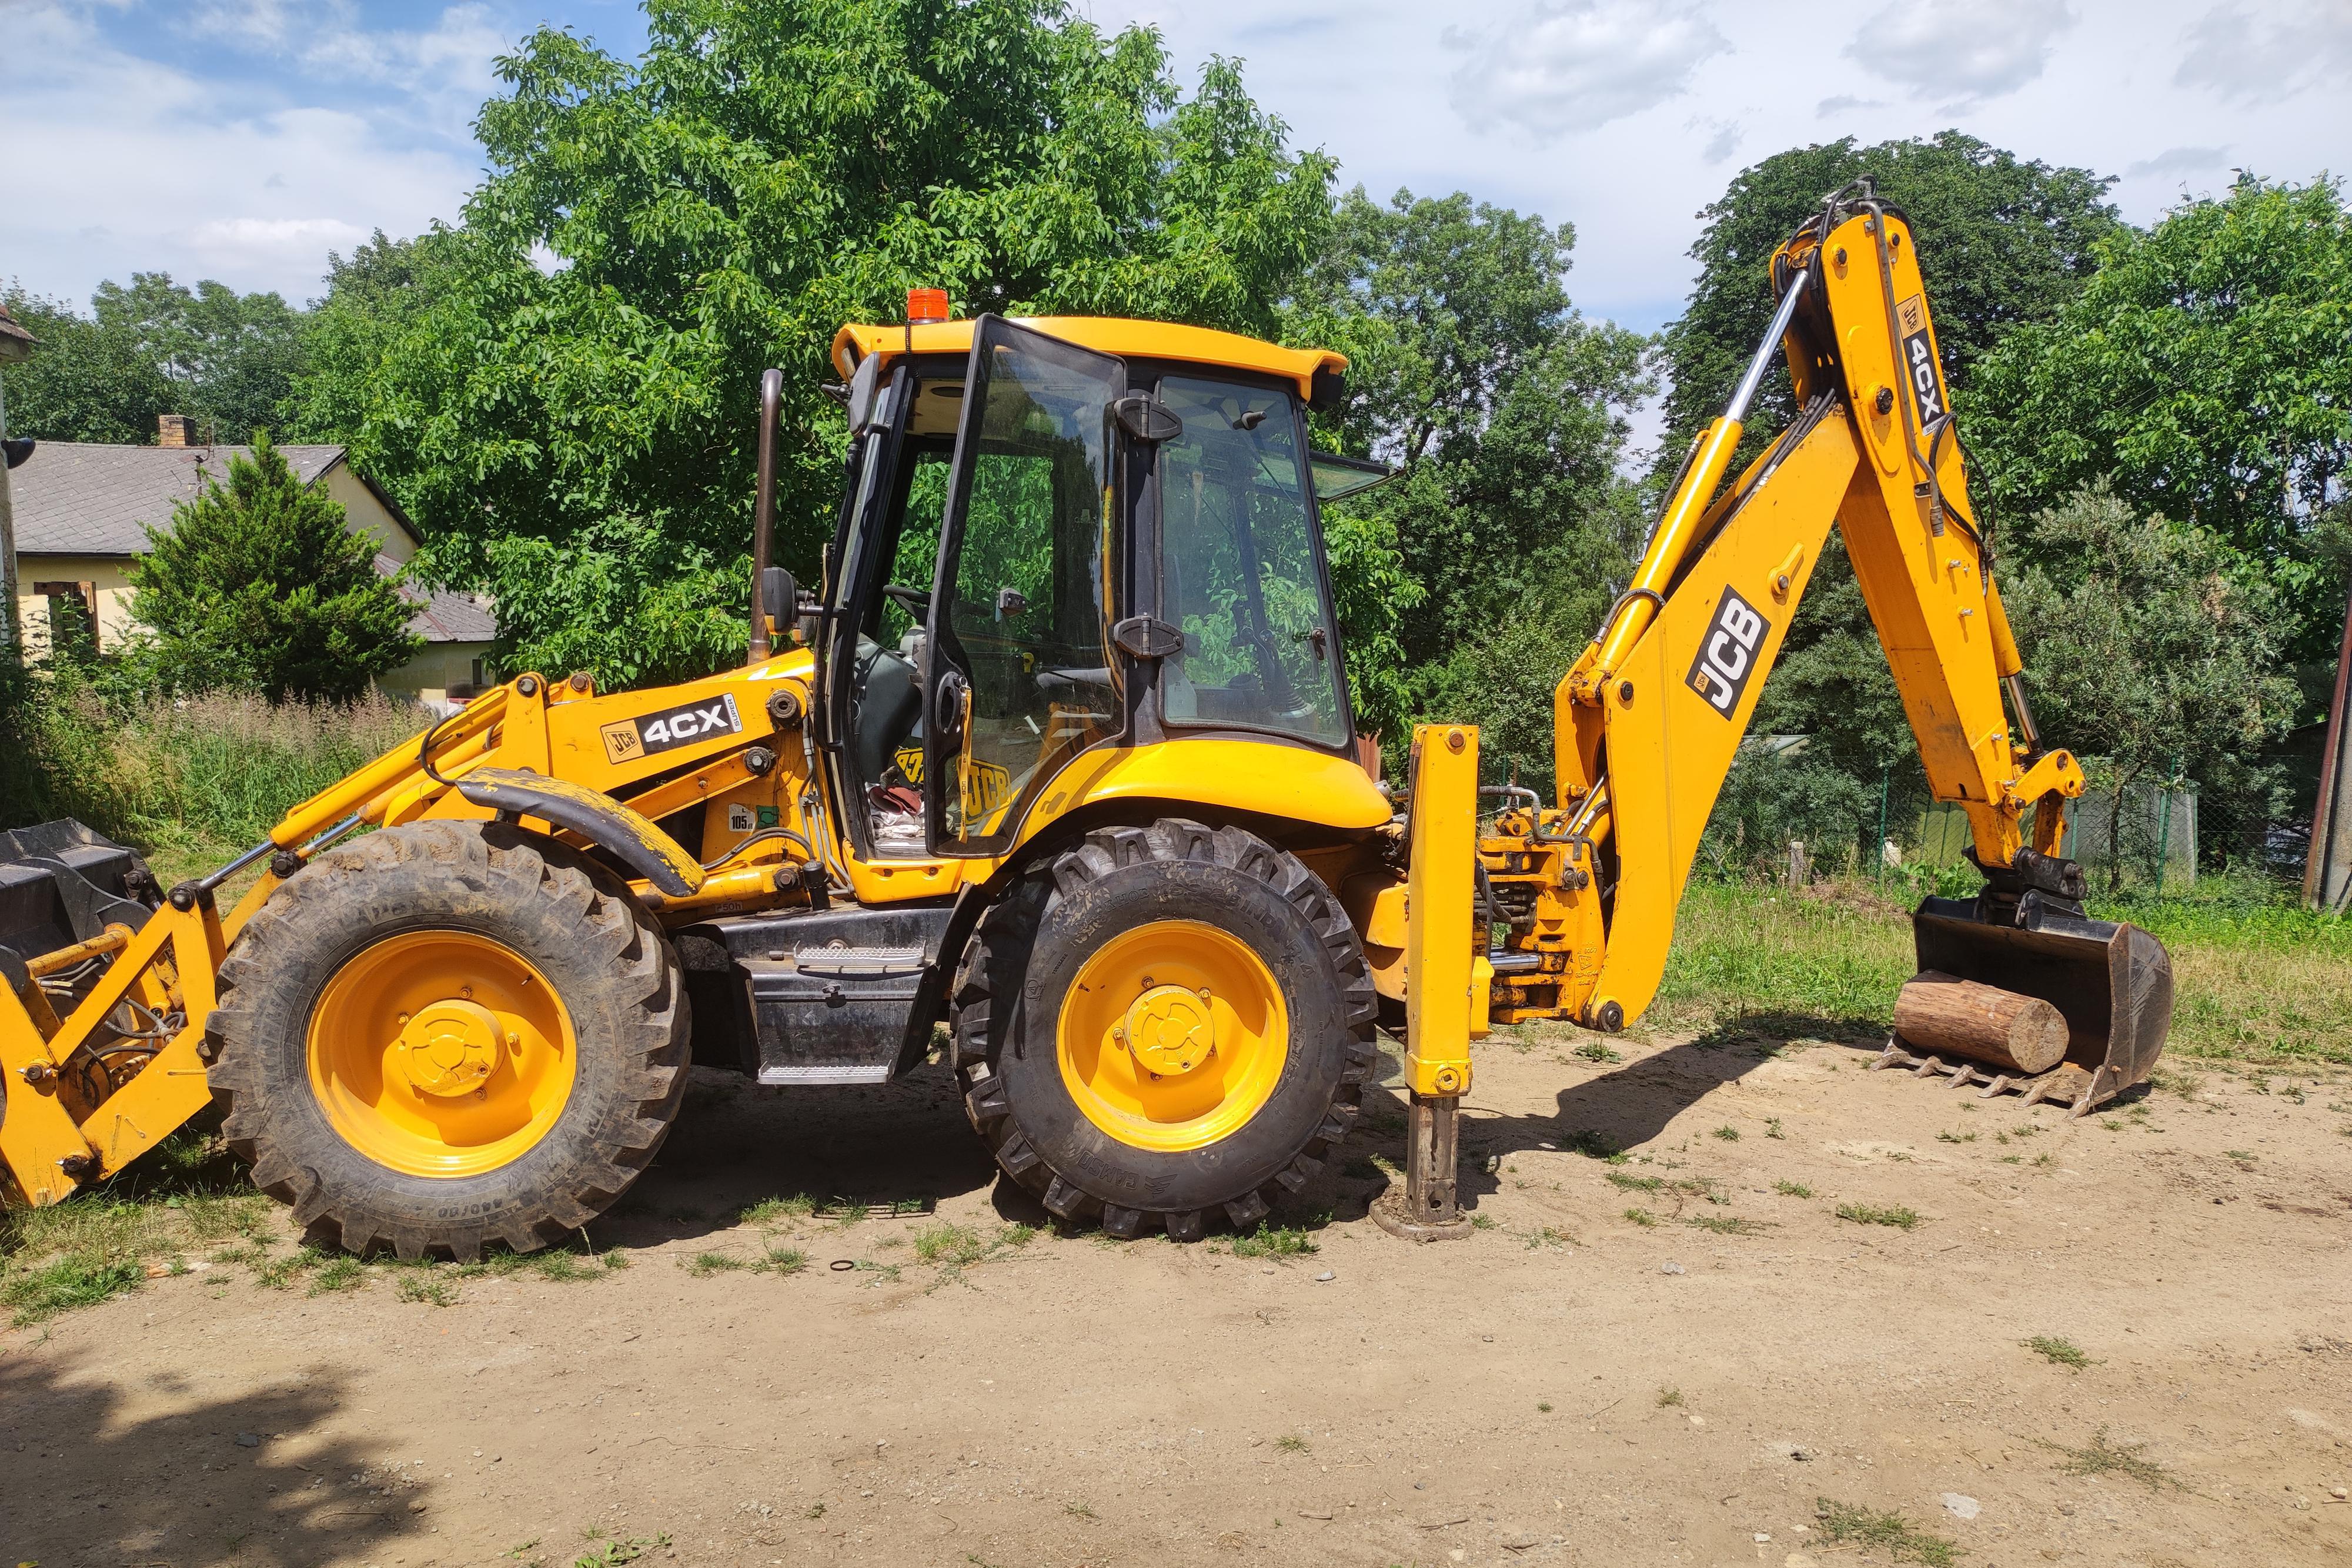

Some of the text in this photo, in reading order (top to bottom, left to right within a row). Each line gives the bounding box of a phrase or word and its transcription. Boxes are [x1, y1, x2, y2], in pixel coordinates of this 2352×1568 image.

[1904, 305, 1917, 330] JCB
[1911, 337, 1940, 422] 4CX
[1700, 598, 1762, 709] JCB
[644, 704, 729, 743] 4CX
[727, 699, 740, 727] SUPER
[611, 733, 636, 753] JCB
[967, 765, 1008, 817] JCB
[731, 815, 747, 830] 105
[723, 902, 741, 911] 50h
[1282, 940, 1316, 978] R-4
[1077, 1150, 1139, 1190] CAMSO
